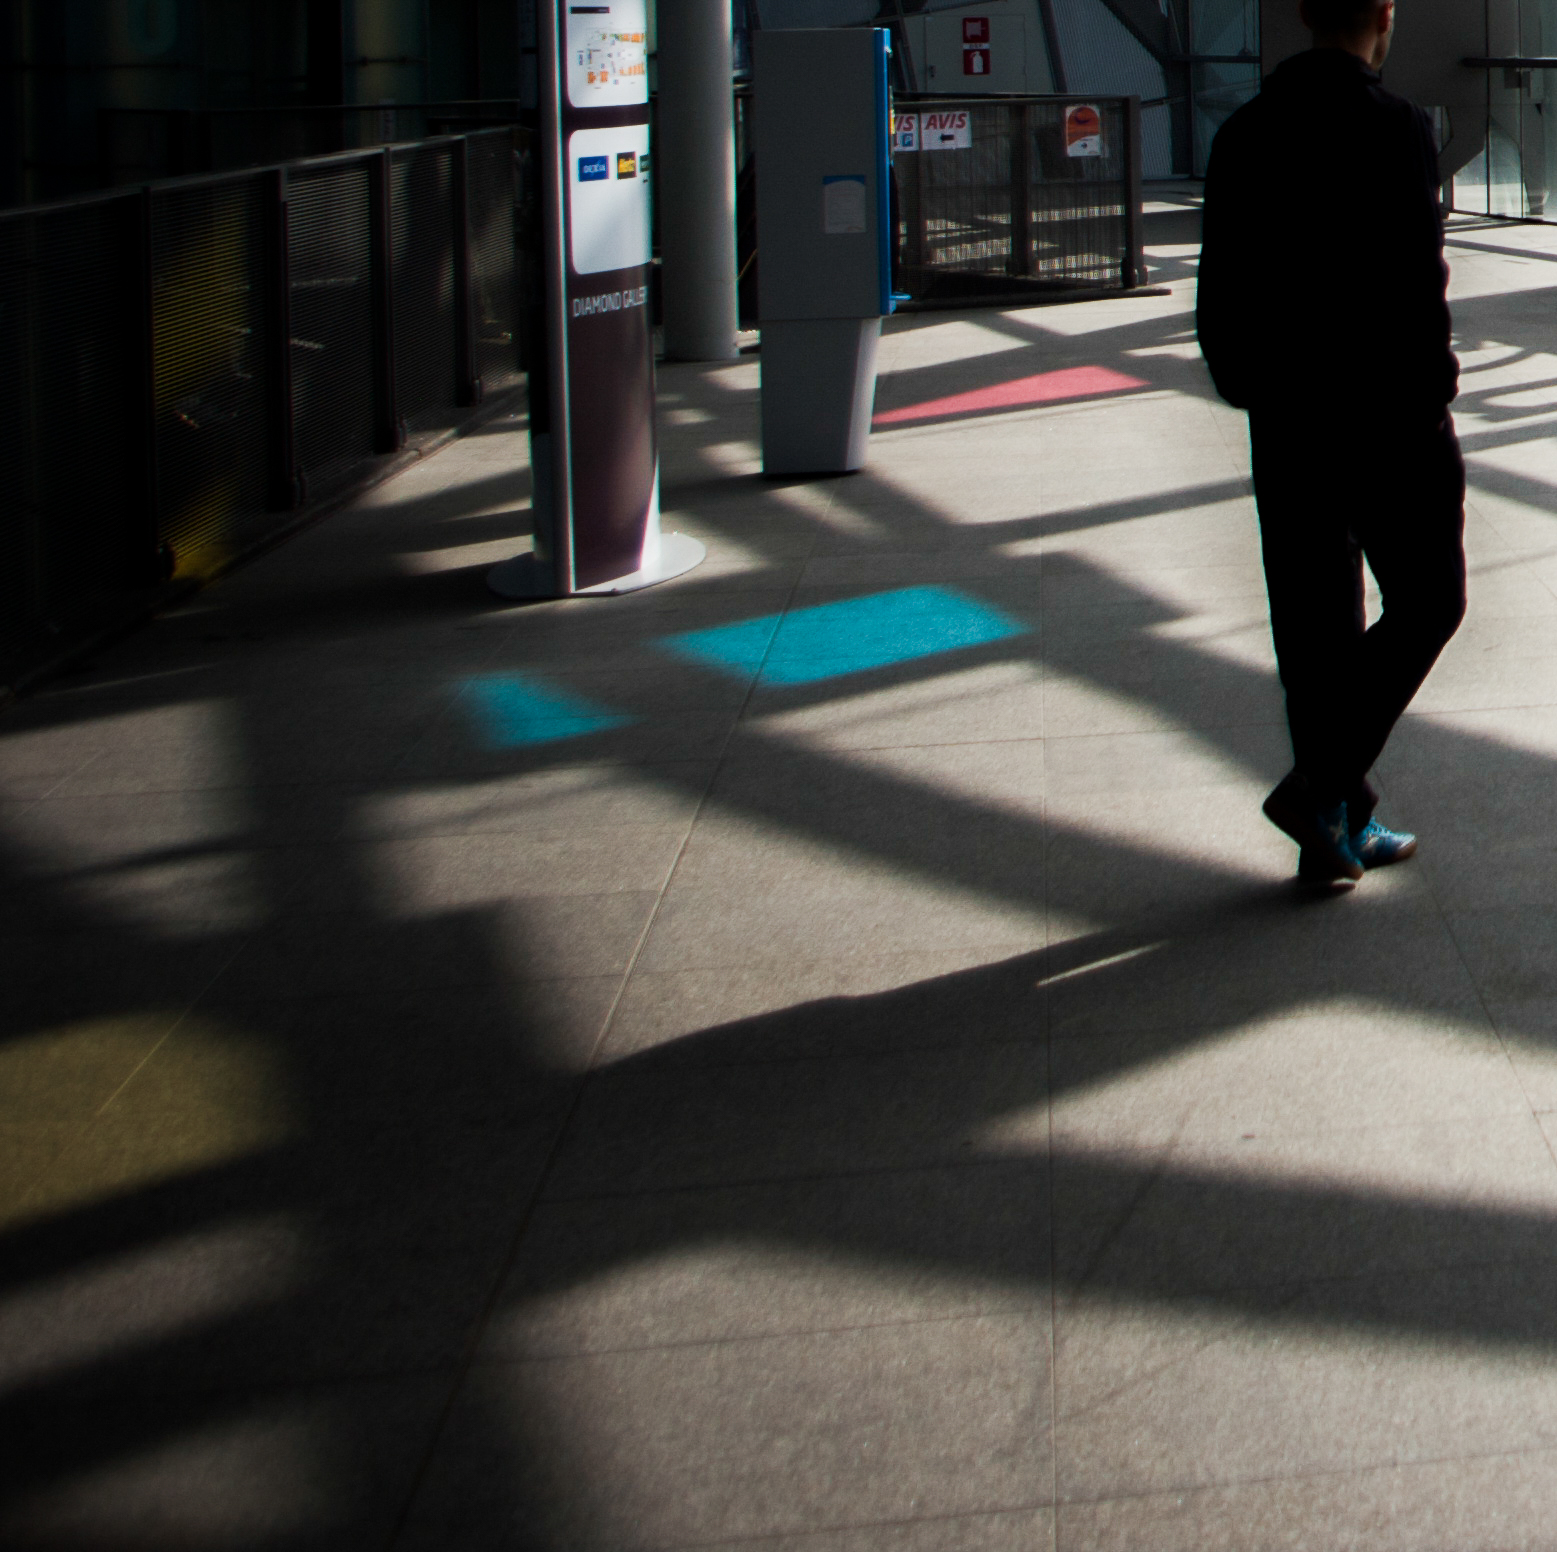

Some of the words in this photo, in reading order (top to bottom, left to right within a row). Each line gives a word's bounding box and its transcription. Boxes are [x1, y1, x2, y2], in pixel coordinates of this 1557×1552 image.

[894, 114, 916, 132] IS
[924, 112, 968, 130] AVIS
[573, 292, 621, 317] DIAMOND
[623, 287, 646, 308] GALLE
